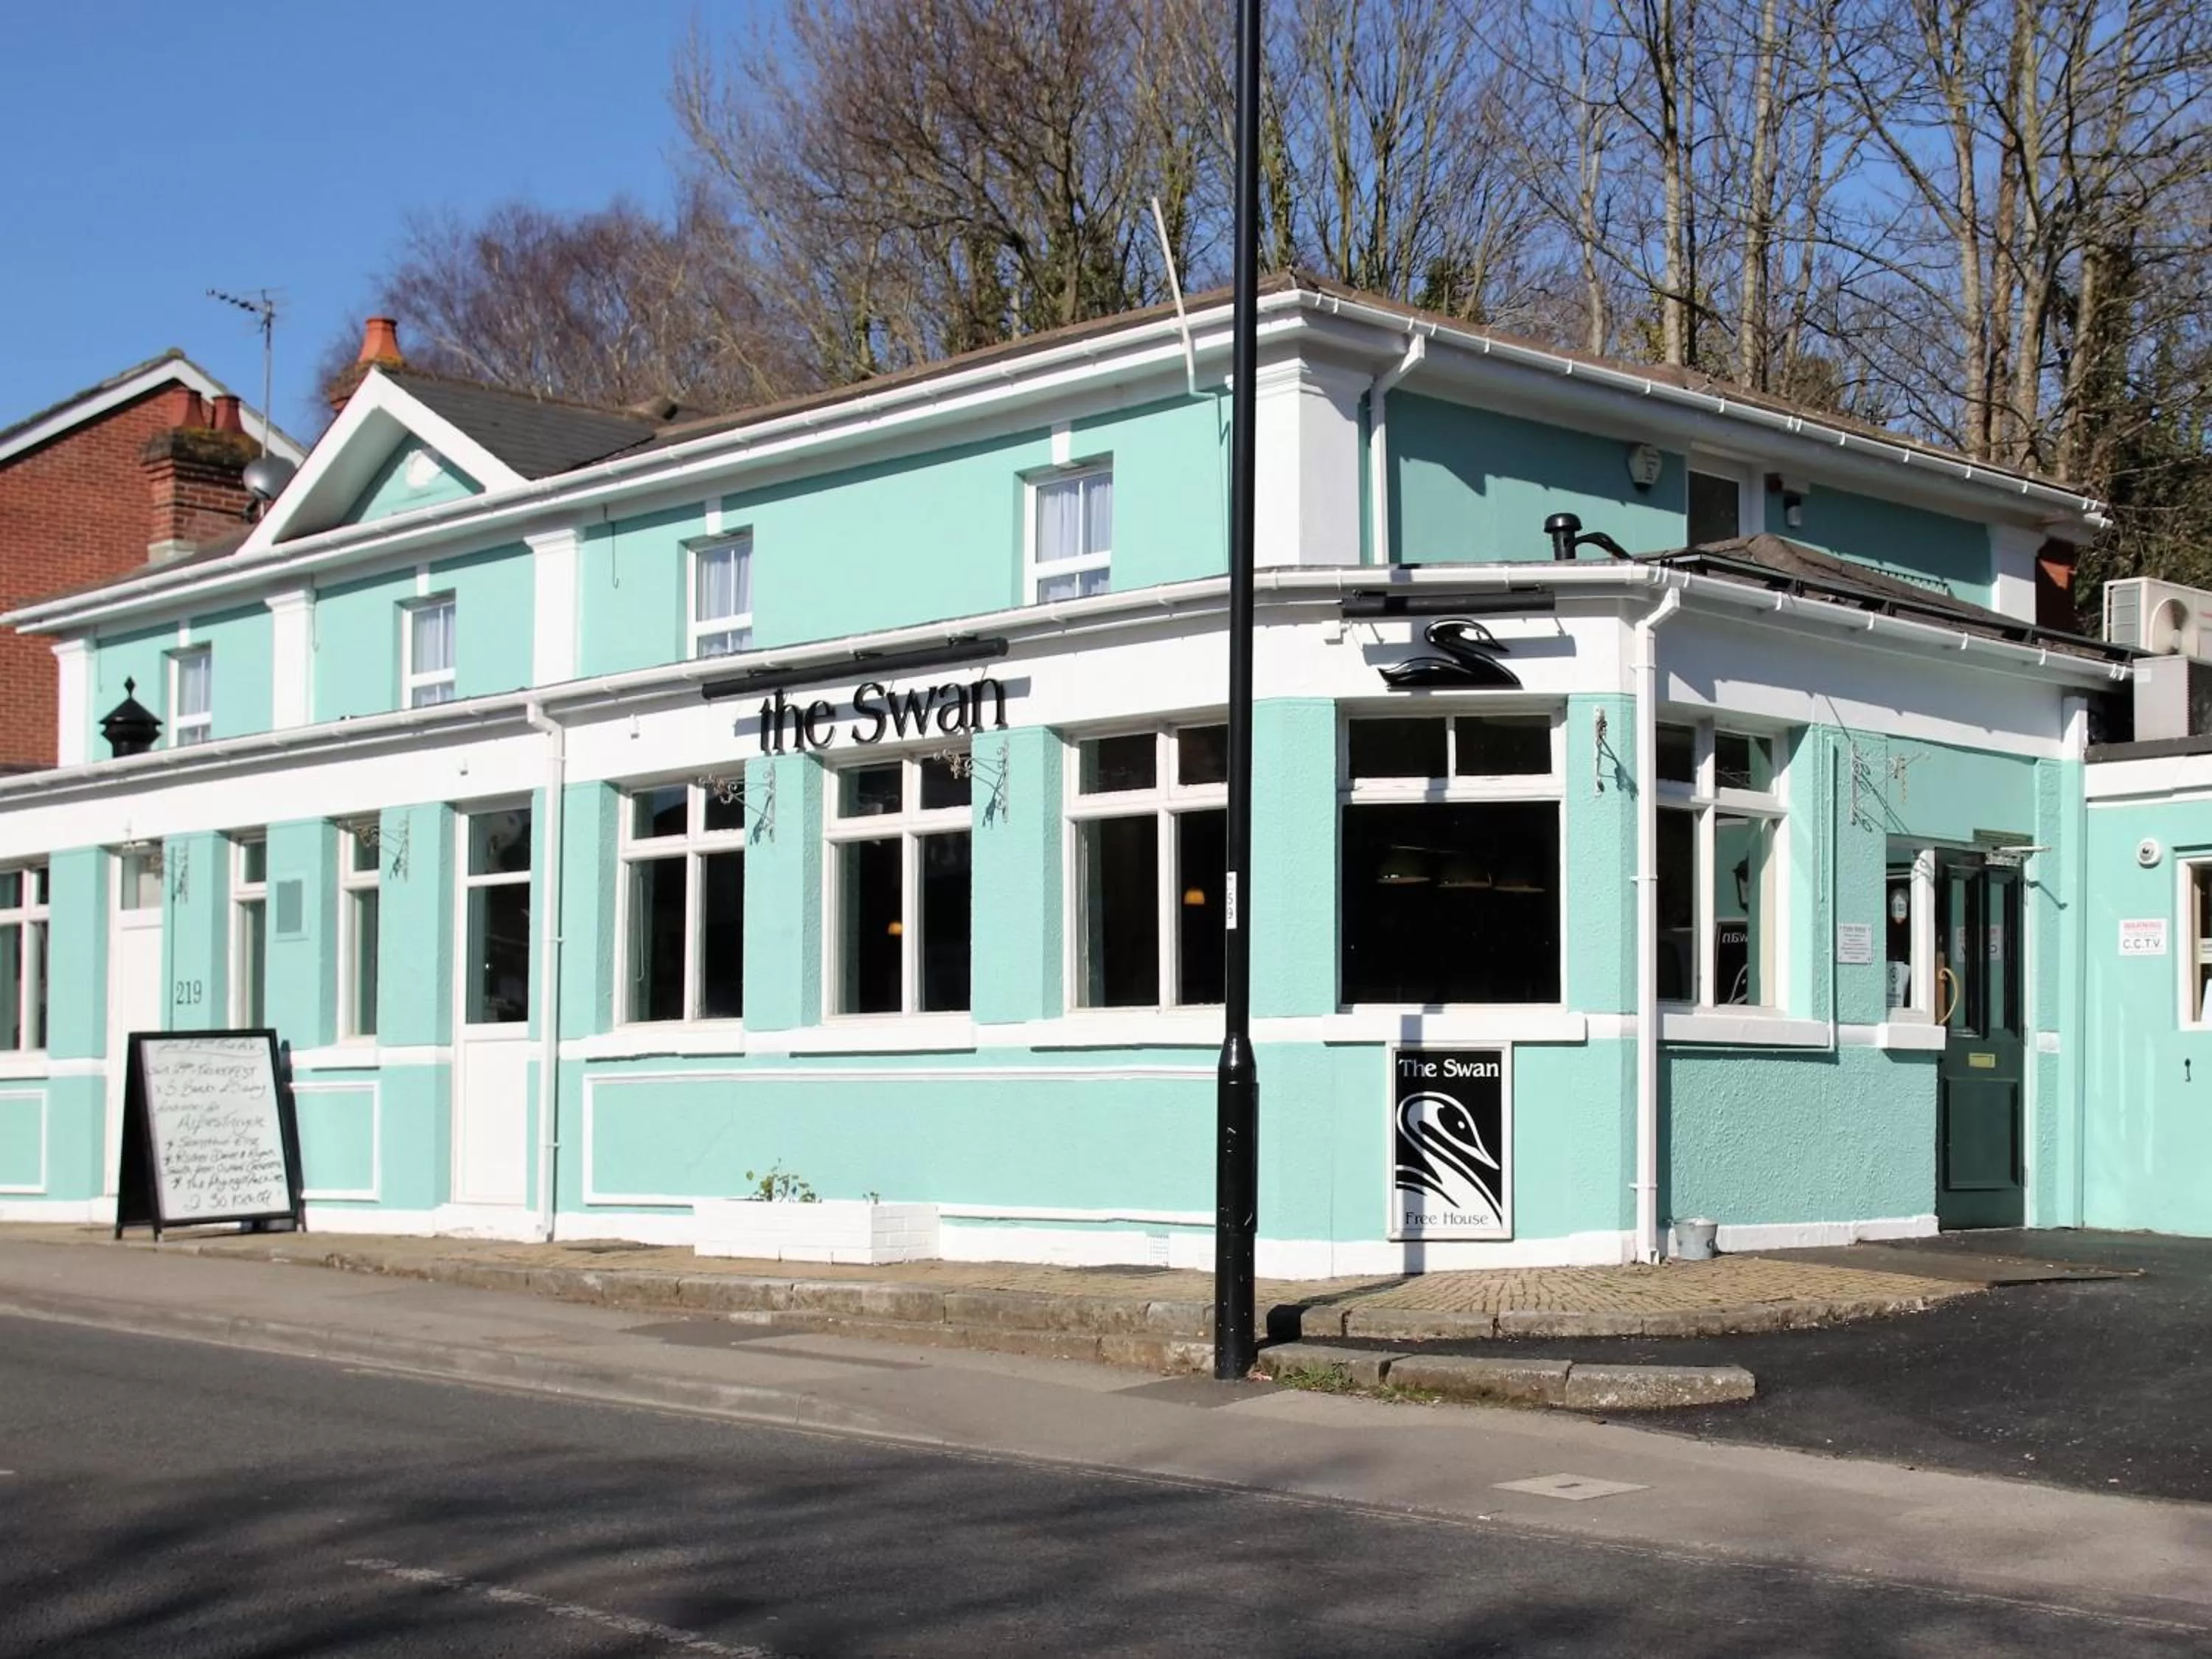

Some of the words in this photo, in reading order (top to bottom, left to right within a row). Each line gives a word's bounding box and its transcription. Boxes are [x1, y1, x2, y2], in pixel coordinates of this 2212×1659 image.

[759, 688, 836, 755] the
[851, 677, 1009, 745] Swan
[175, 981, 202, 1005] 219
[1398, 1059, 1437, 1078] The
[1443, 1059, 1499, 1077] Swan
[1405, 1211, 1437, 1225] Free
[1443, 1211, 1489, 1225] House
